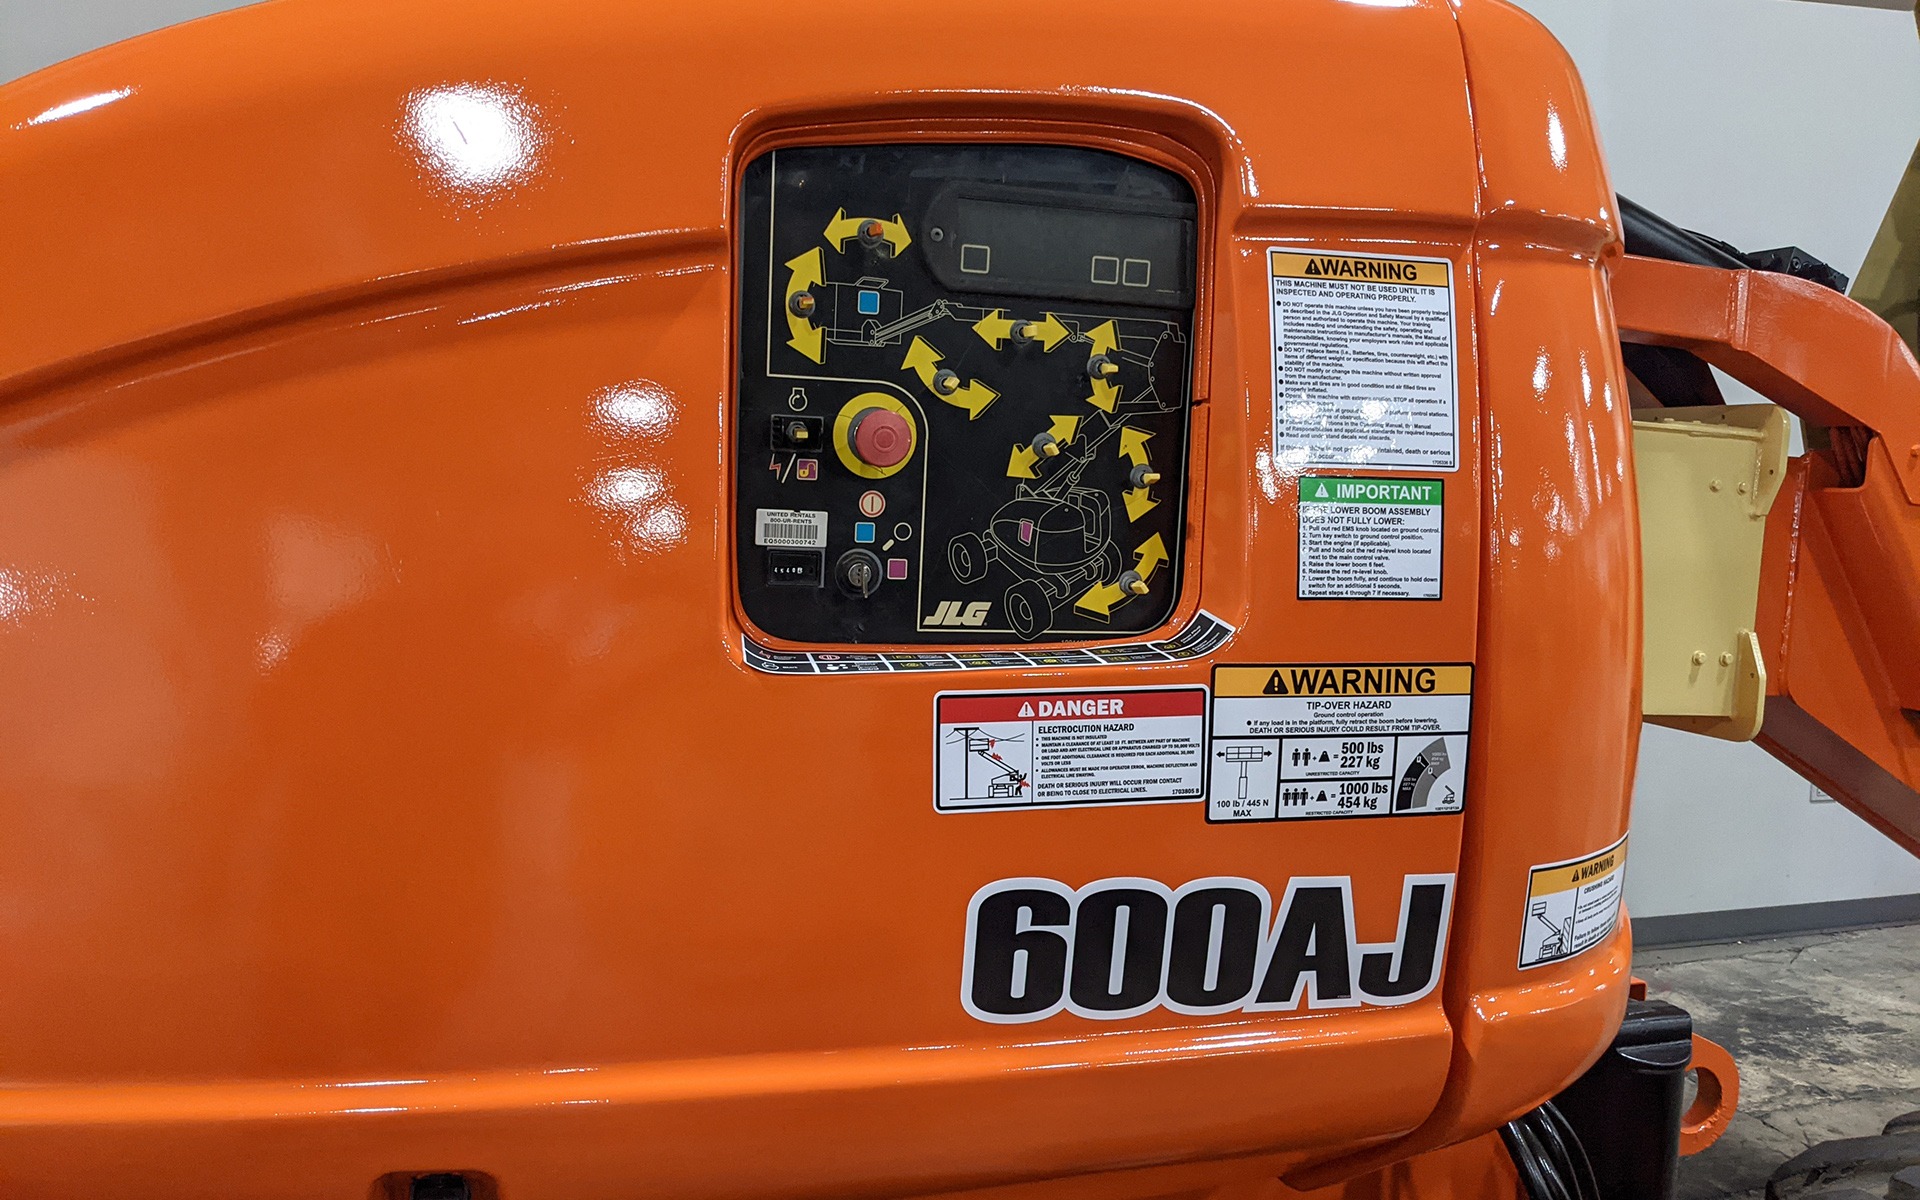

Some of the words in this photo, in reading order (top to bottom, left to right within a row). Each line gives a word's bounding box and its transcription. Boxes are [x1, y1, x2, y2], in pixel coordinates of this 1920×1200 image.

[1320, 258, 1417, 281] WARNING
[1294, 280, 1327, 289] MACHINE
[1276, 288, 1317, 296] INSPECTED
[1335, 292, 1376, 300] OPERATING
[1378, 294, 1416, 302] PROPERLY.
[1337, 484, 1432, 500] IMPORTANT
[1388, 508, 1430, 516] ASSEMBLY
[923, 601, 992, 626] JLG
[1290, 668, 1435, 694] WARNING
[1039, 699, 1123, 717] DANGER
[1307, 701, 1350, 710] TIP-OVER
[1353, 701, 1391, 709] HAZARD
[1038, 724, 1101, 734] ELECTROCUTION
[1103, 723, 1134, 732] HAZARD
[1341, 742, 1364, 754] 500
[1367, 742, 1383, 754] lbs
[1340, 756, 1363, 768] 227
[1366, 755, 1380, 770] kg
[1339, 782, 1369, 795] 1000
[1372, 782, 1388, 794] lbs
[1337, 796, 1360, 808] 454
[1363, 796, 1378, 810] kg
[1581, 855, 1614, 879] WARNING
[970, 882, 1448, 1017] 600AJ
